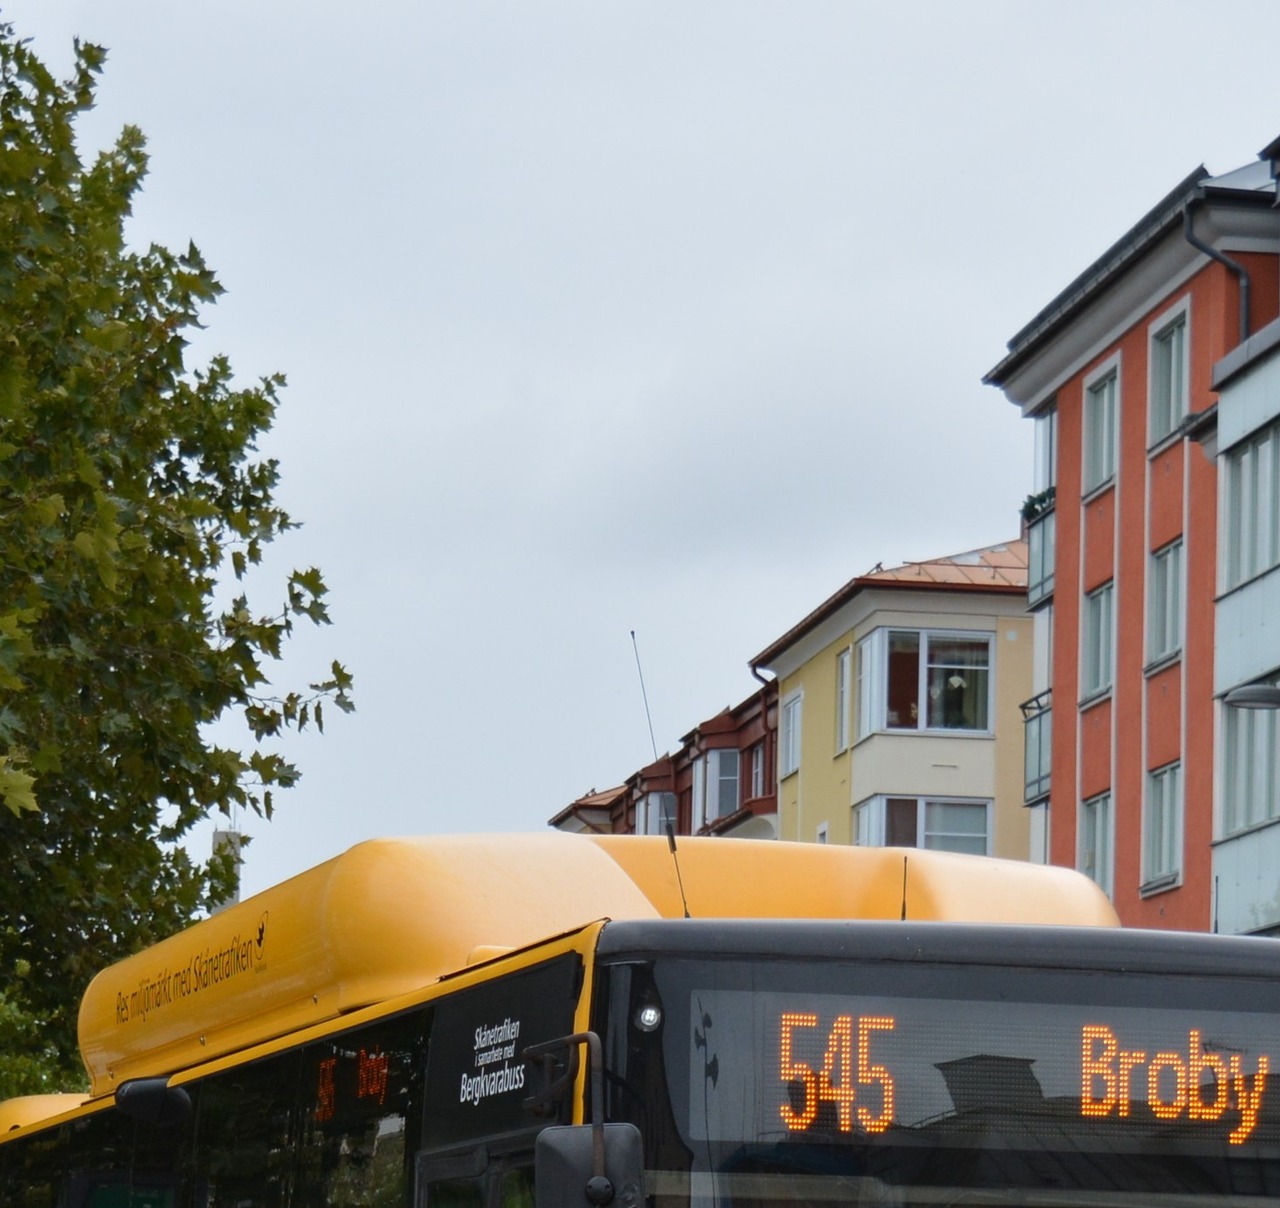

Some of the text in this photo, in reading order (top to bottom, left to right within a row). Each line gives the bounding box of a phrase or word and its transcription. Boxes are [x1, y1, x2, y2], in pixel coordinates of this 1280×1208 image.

[116, 934, 253, 1024] Res miljömärkt med Skånetrafiken
[474, 1017, 520, 1050] Skånetrafiken
[478, 1046, 503, 1067] samarbete
[503, 1040, 516, 1059] med
[460, 1060, 525, 1106] Bergkvarabuss
[780, 1014, 1269, 1144] 545 Broby
